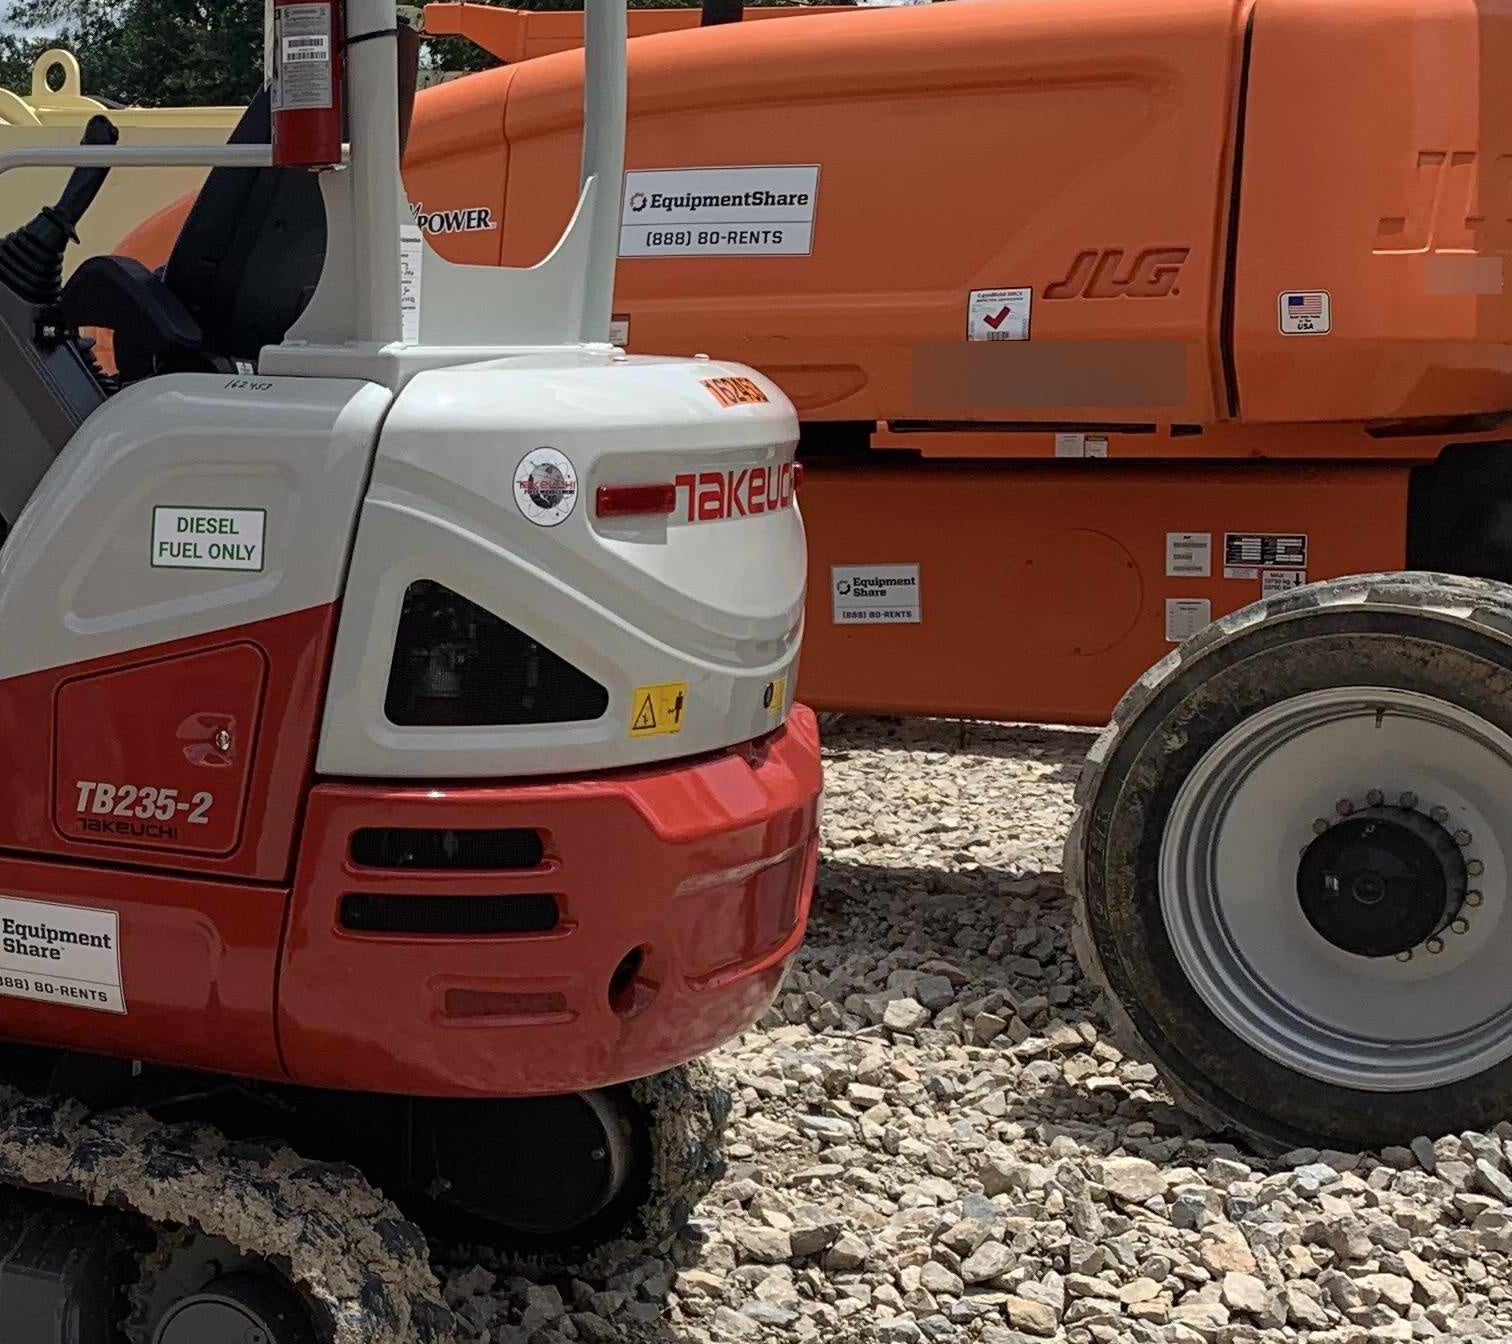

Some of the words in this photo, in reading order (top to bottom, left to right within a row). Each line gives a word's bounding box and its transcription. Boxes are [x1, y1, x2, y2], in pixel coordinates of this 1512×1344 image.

[649, 191, 809, 212] EquipmentShare
[646, 231, 692, 246] (888)
[697, 230, 783, 245] 80-RENTS
[1042, 247, 1191, 299] JLG
[1297, 322, 1314, 331] USA
[177, 516, 240, 535] DIESEL
[159, 542, 202, 559] FUEL
[208, 543, 256, 561] ONLY
[853, 577, 916, 588] Equipment
[853, 587, 887, 597] Share
[76, 780, 214, 825] TB235-2
[2, 917, 112, 950] Equipment
[3, 937, 61, 961] Share
[34, 981, 108, 1003] 80-RENTS
